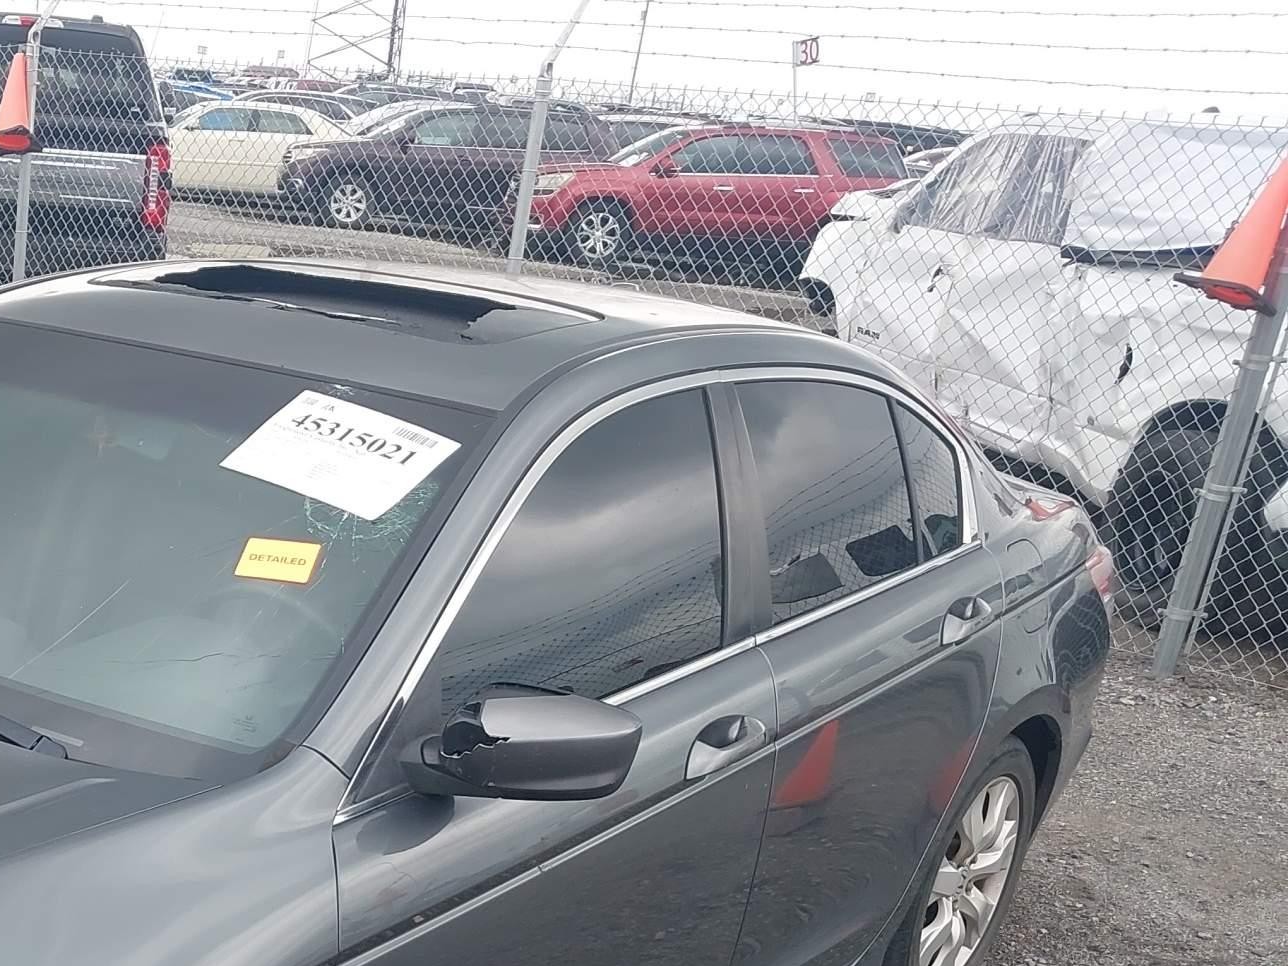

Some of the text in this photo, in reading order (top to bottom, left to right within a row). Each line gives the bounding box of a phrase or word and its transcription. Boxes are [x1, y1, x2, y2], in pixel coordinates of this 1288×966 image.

[800, 40, 819, 64] 30
[291, 414, 417, 465] 45315021
[249, 553, 307, 566] DETAILED
